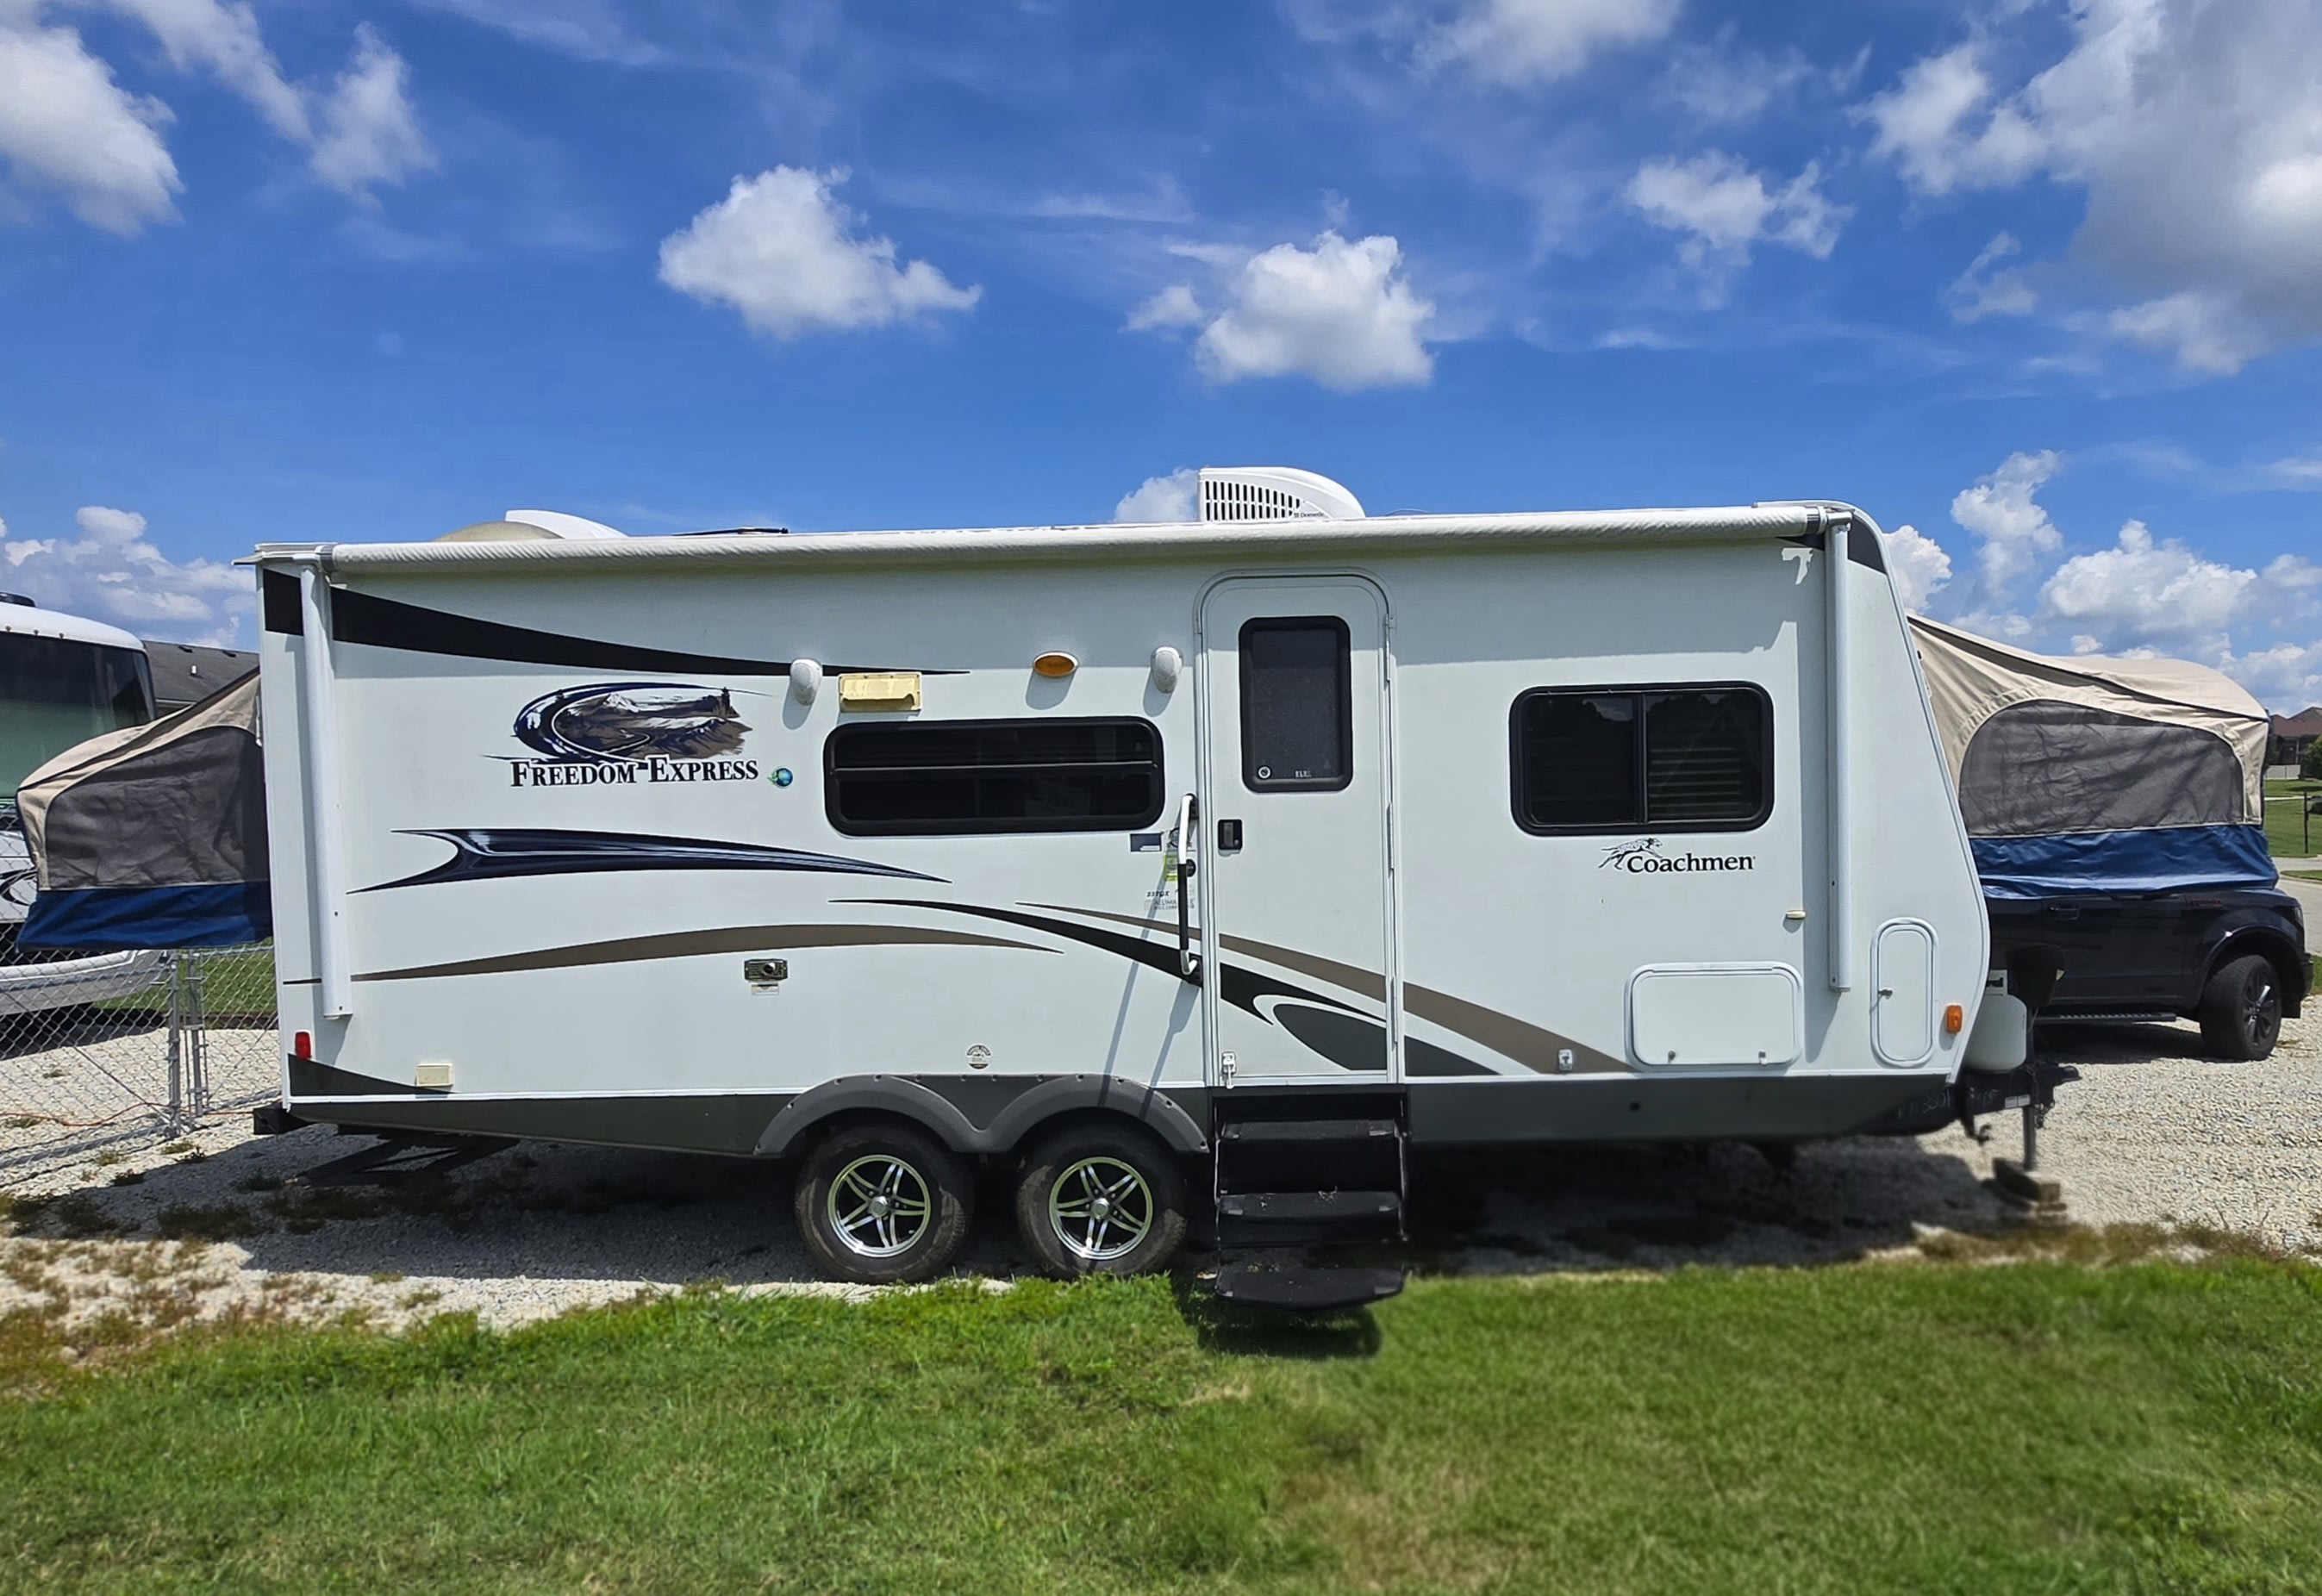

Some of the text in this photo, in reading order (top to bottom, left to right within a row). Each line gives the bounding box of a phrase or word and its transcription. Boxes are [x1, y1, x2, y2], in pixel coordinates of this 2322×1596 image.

[510, 757, 758, 787] FREEDOM EXPRESS
[1627, 853, 1753, 873] Coachmen
